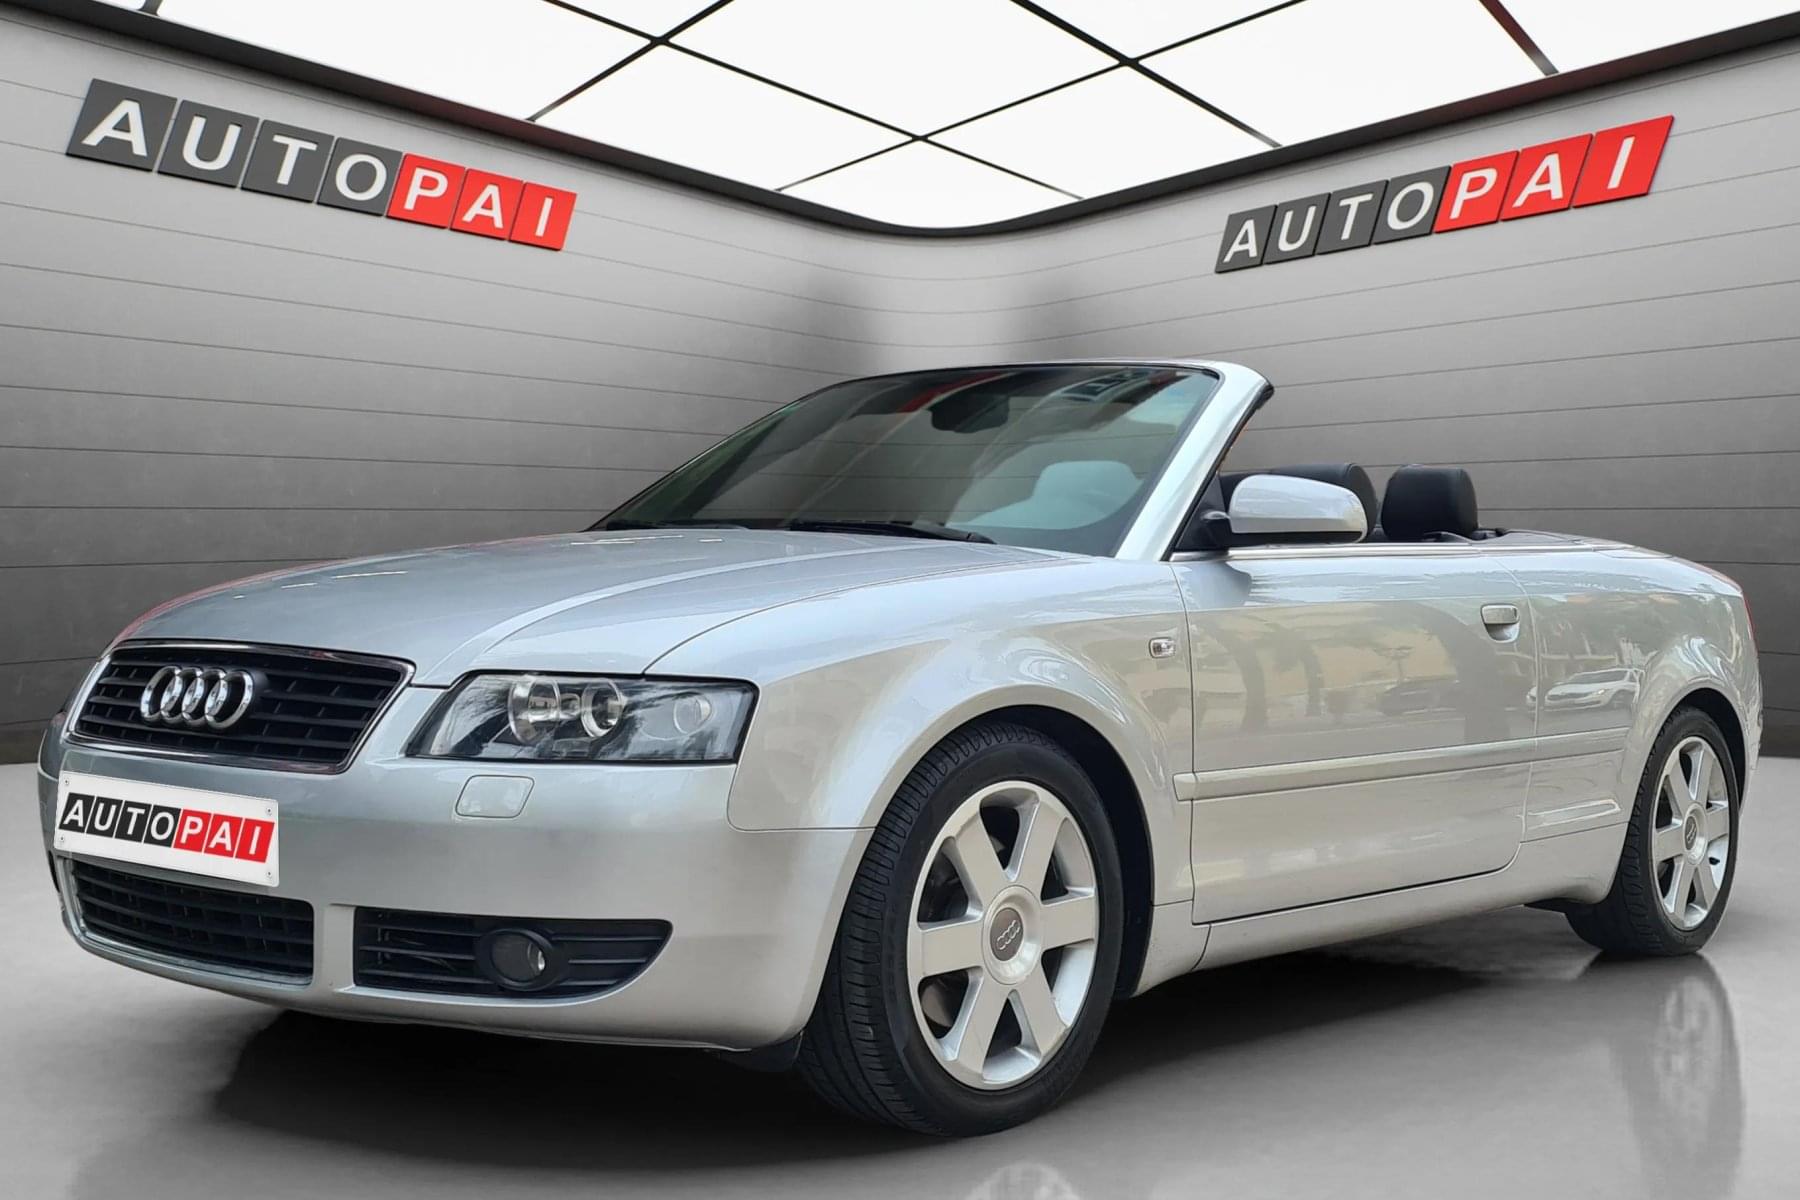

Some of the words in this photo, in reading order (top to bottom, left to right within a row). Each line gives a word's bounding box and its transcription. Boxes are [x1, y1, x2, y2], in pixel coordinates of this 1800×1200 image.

[81, 100, 553, 237] AUTOPAI
[1223, 136, 1634, 262] AUTOPAI
[63, 799, 261, 855] AUTOPAI
